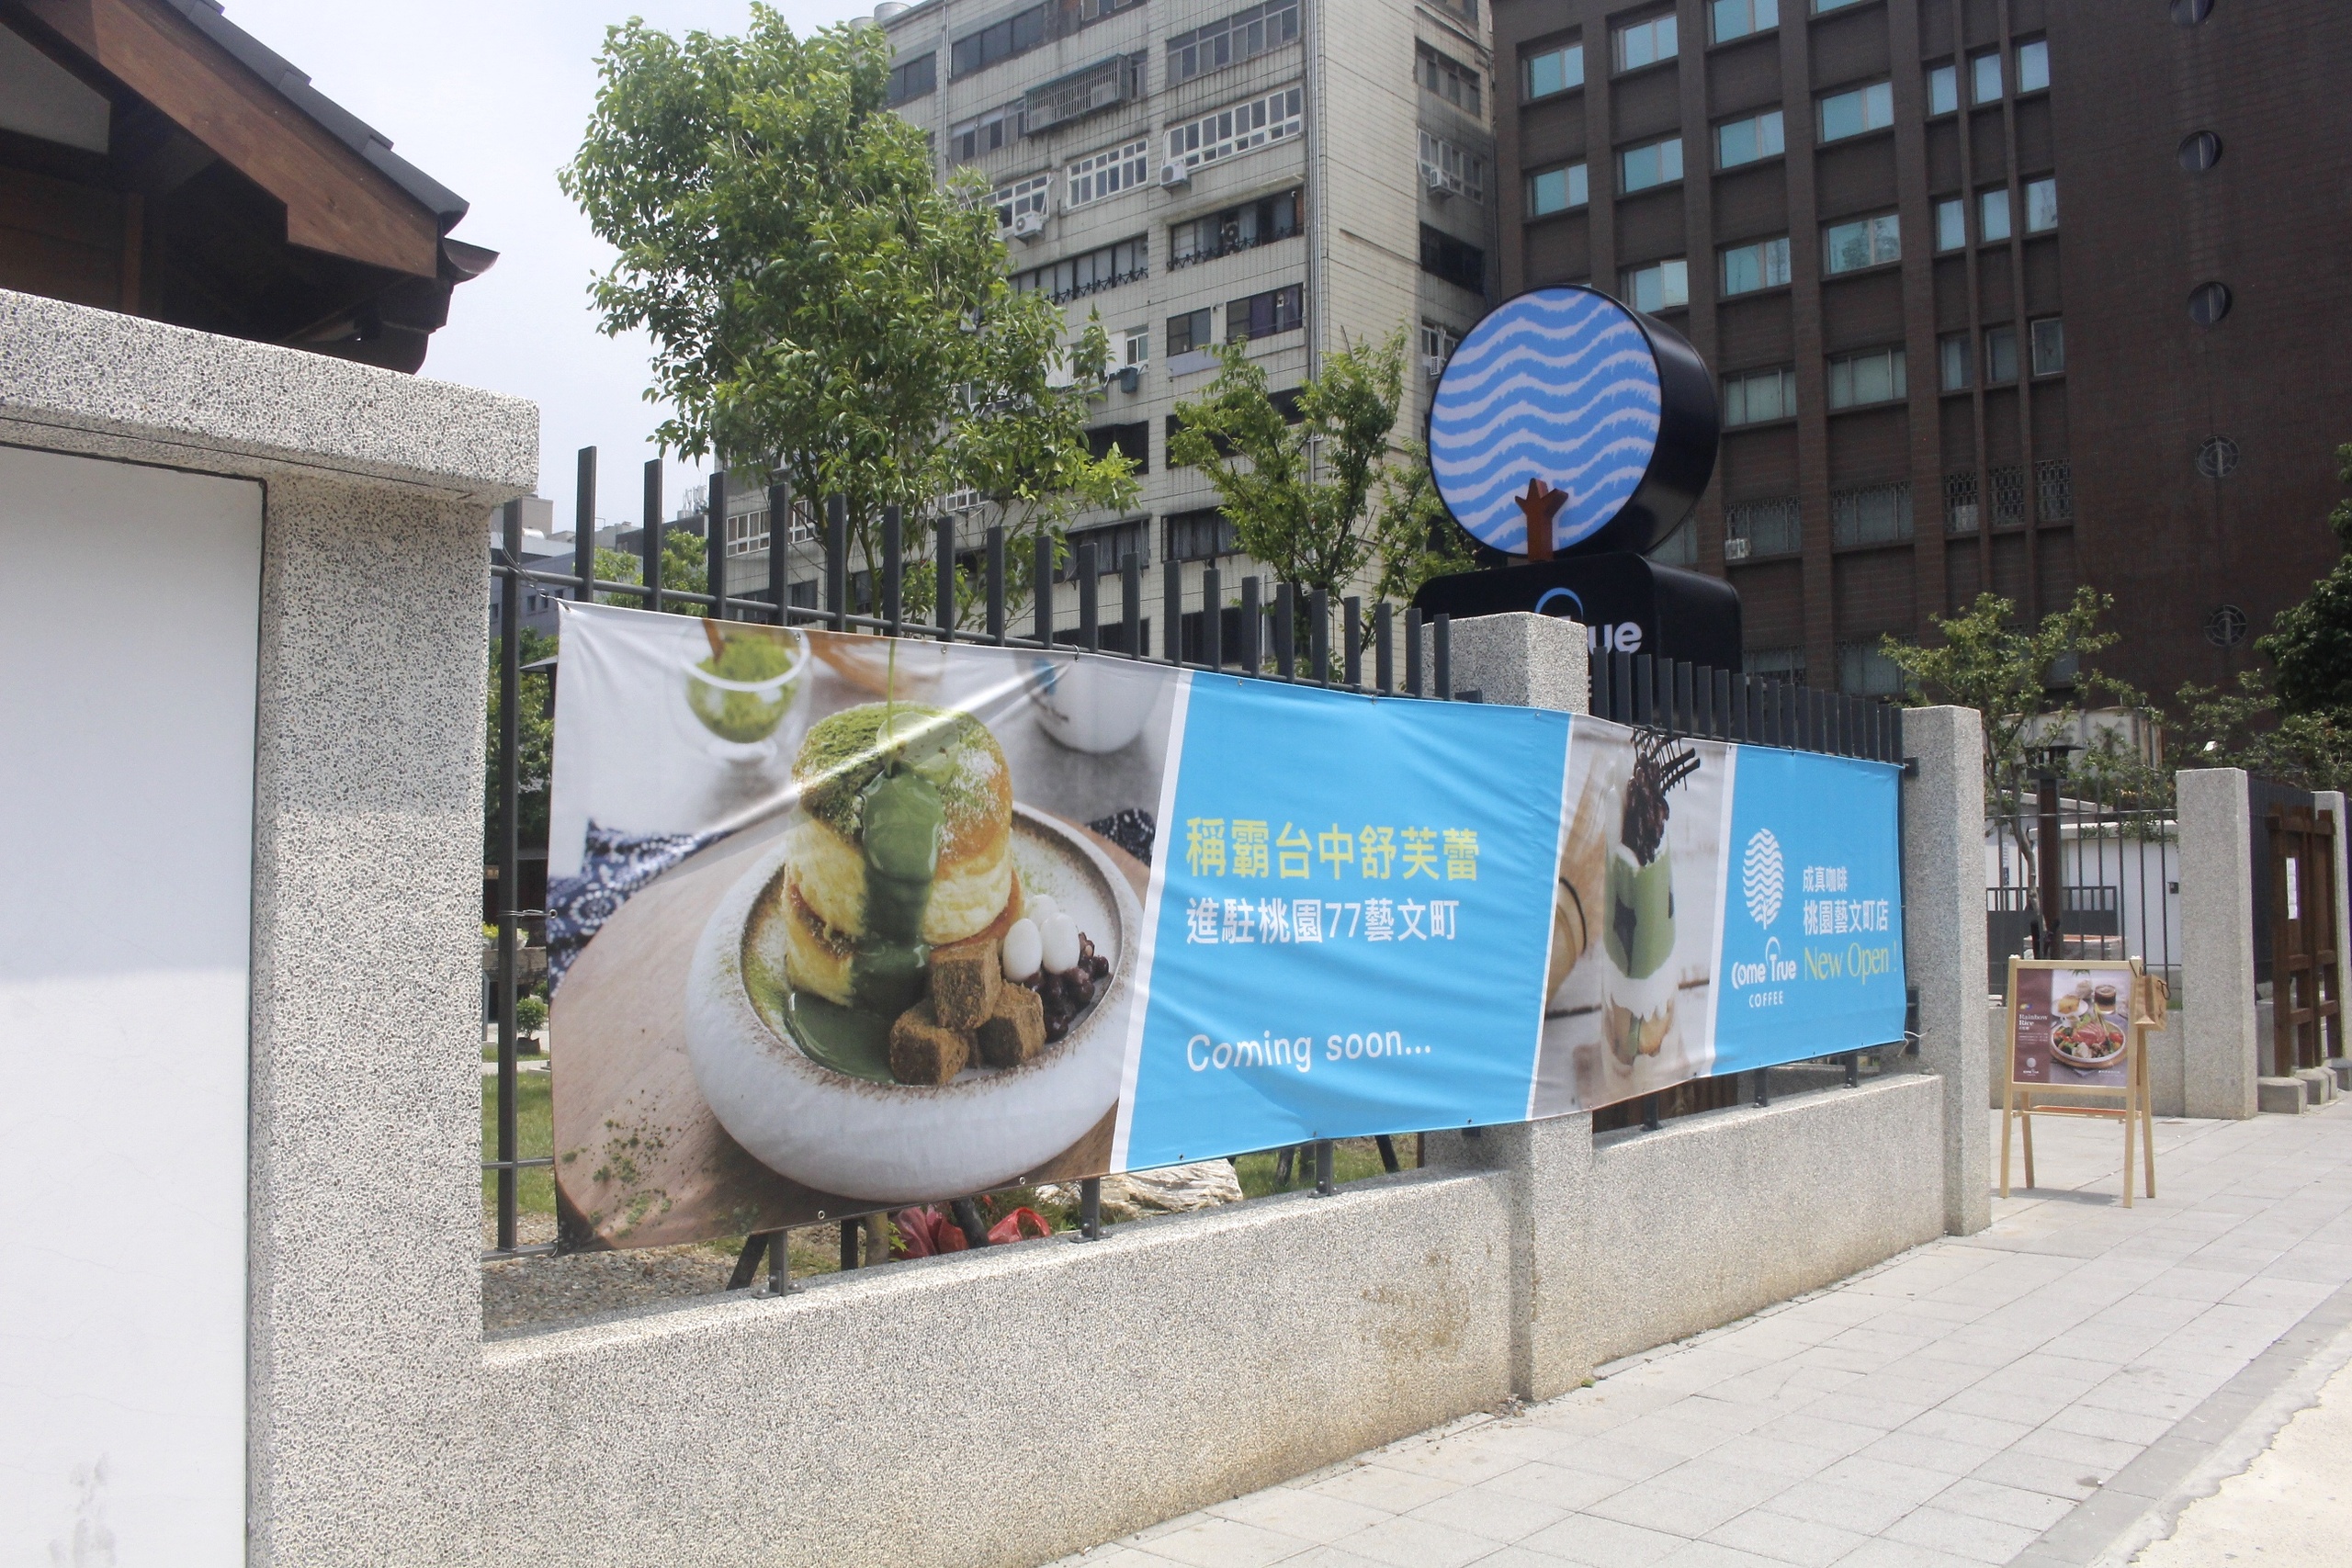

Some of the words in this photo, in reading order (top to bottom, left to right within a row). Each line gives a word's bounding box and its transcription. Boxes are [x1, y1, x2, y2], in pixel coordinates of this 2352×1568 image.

[1559, 616, 1643, 655] ue
[1186, 817, 1480, 881] 稱霸台中舒芙蕾
[1803, 865, 1848, 893] 成真咖啡
[1186, 897, 1460, 945] 進駐桃園77藝文町
[1803, 898, 1889, 936] 桃園藝文町店
[1731, 961, 1766, 990] Come
[1769, 953, 1797, 982] True
[1804, 946, 1843, 981] New
[1748, 990, 1783, 1008] COFFEE
[1187, 1030, 1312, 1073] Coming
[1325, 1030, 1431, 1062] soon...
